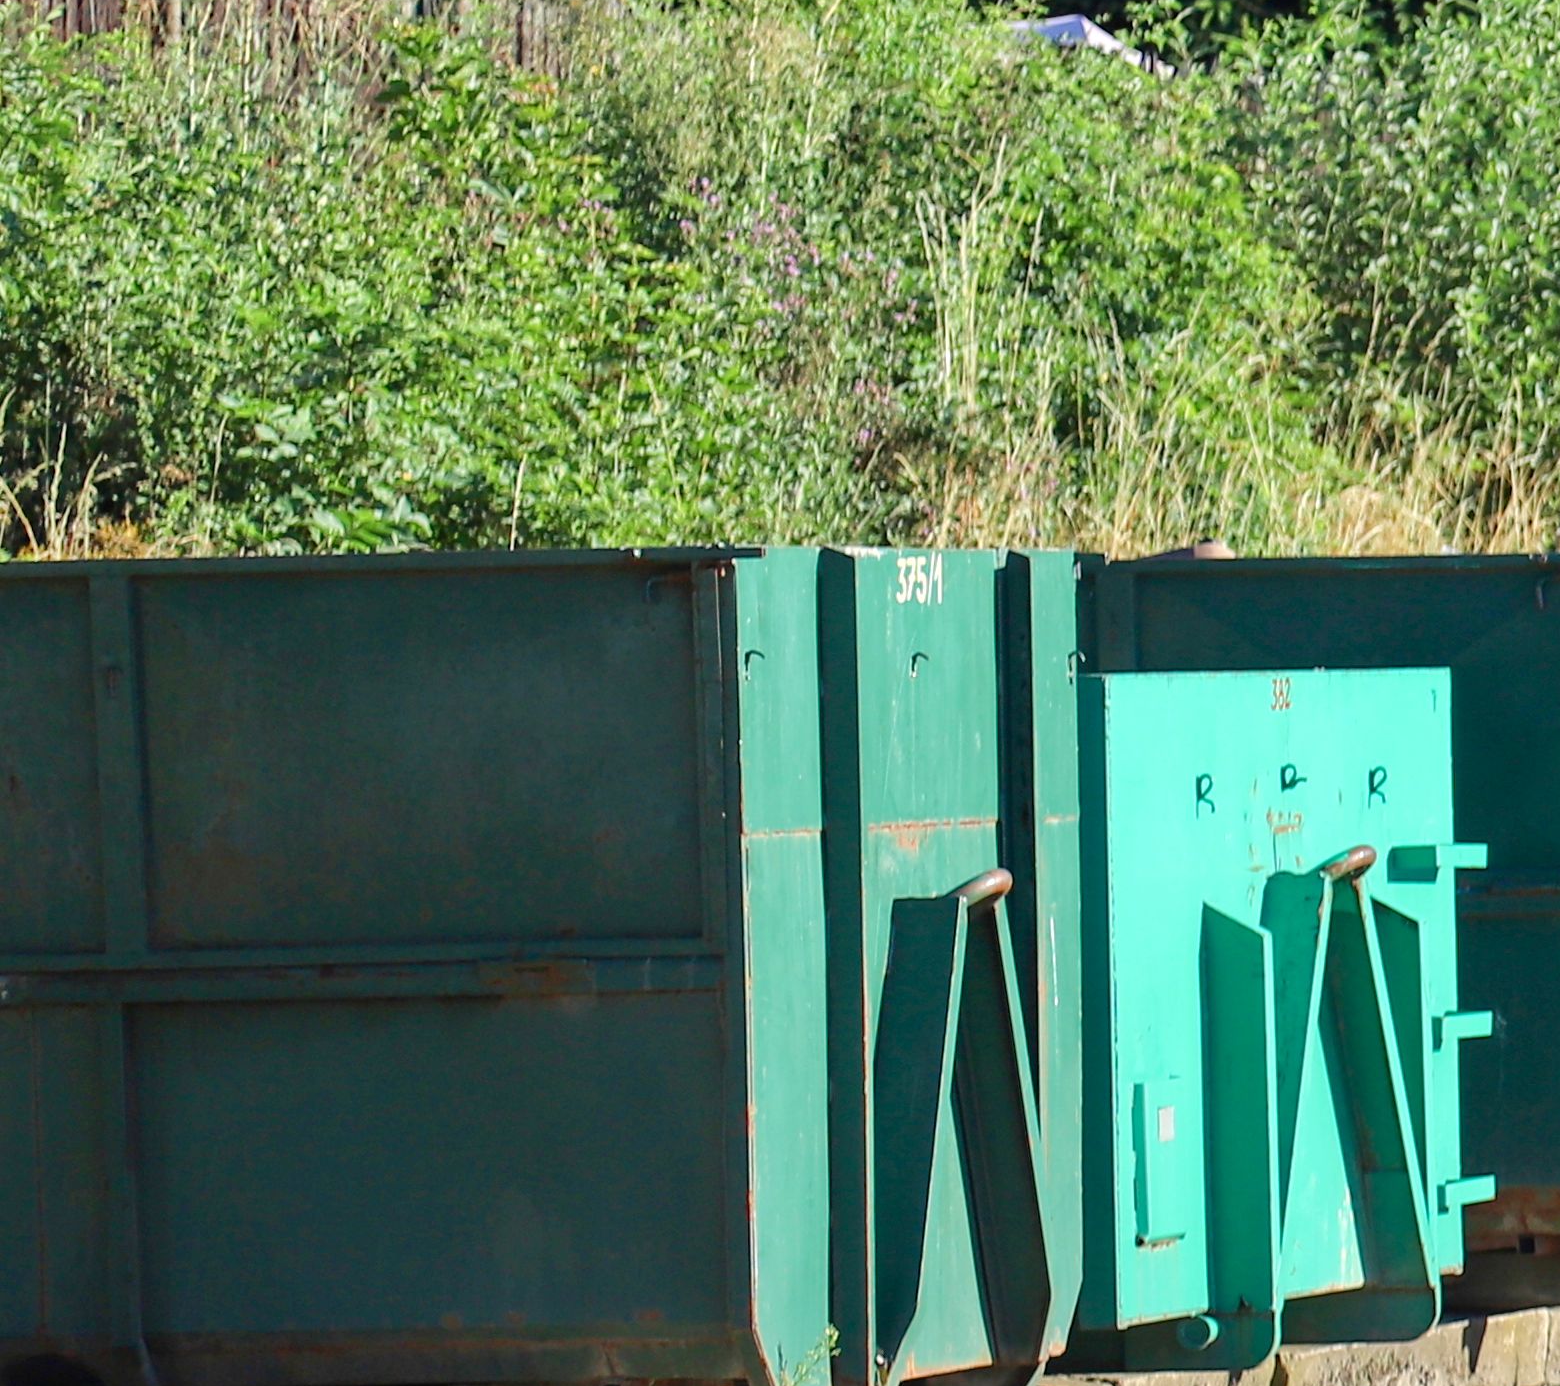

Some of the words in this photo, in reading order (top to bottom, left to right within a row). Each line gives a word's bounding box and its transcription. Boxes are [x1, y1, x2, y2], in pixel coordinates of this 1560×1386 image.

[896, 551, 943, 605] 375/1
[1196, 774, 1215, 819] R
[1368, 766, 1386, 809] R
